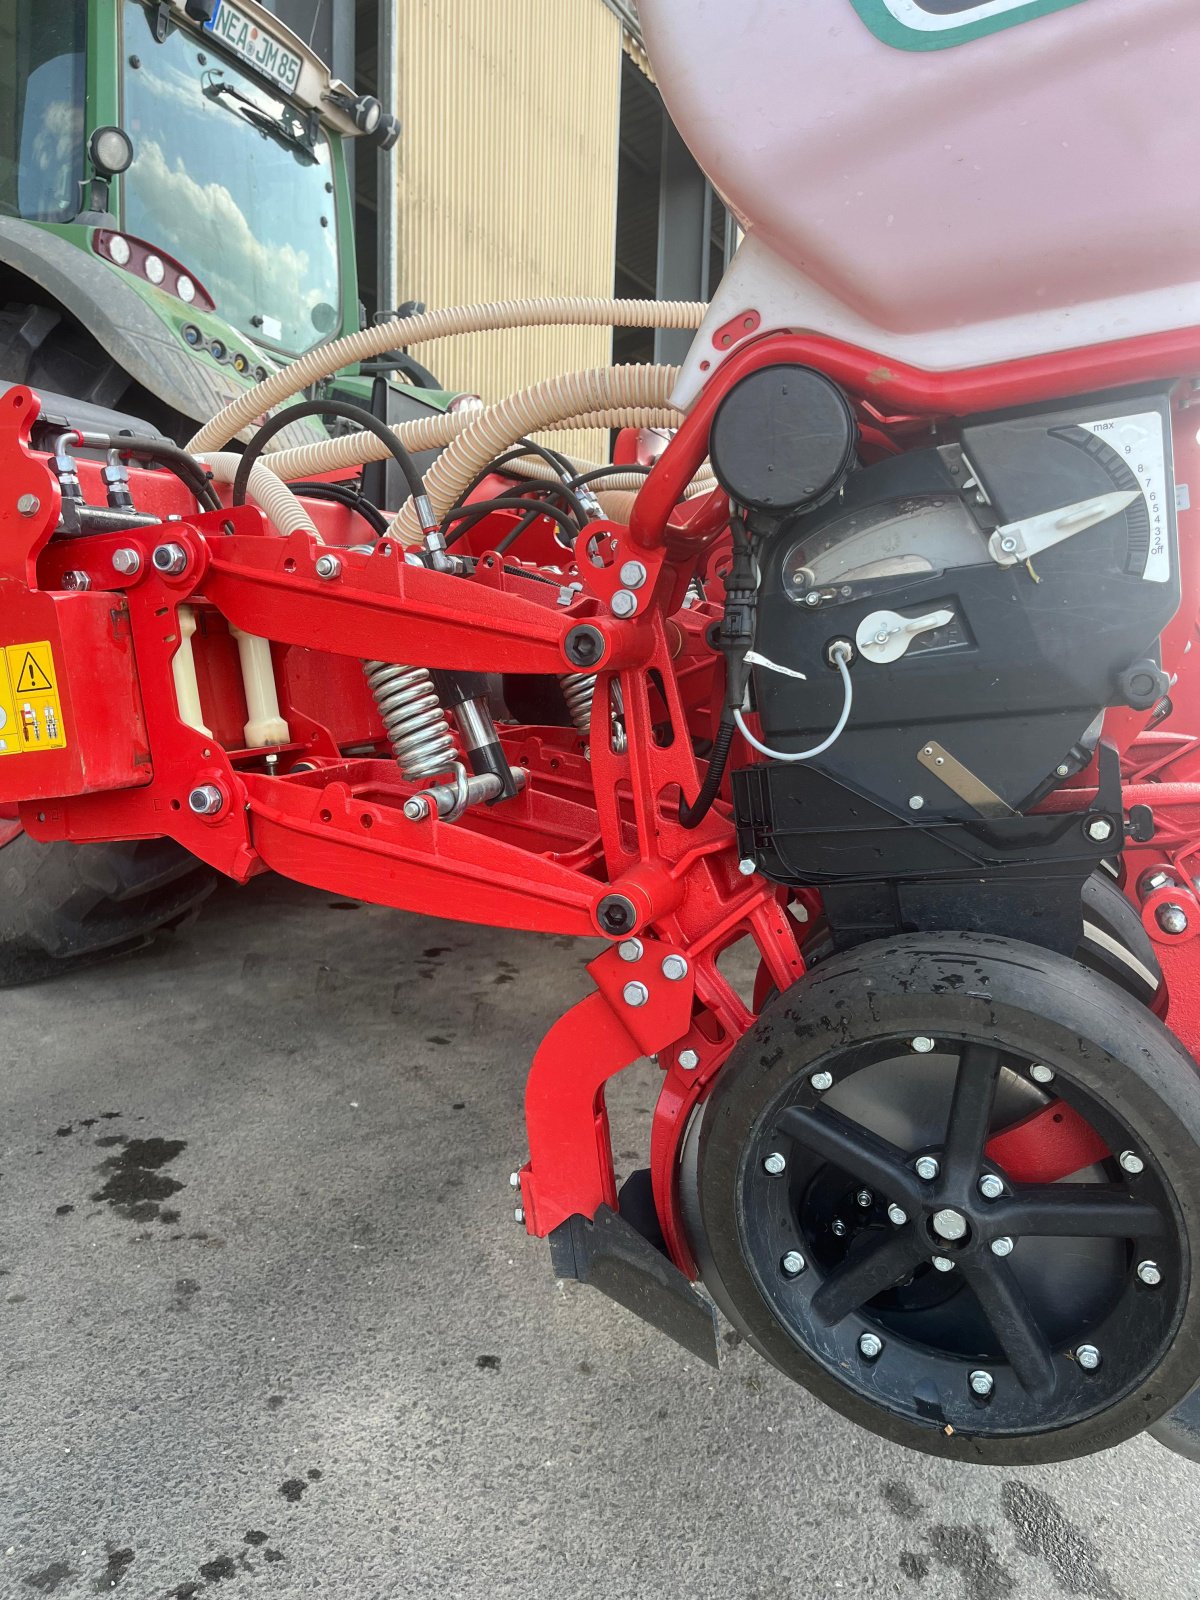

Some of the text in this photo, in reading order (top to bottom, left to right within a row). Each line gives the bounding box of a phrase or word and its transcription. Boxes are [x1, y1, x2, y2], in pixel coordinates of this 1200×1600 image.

[215, 5, 249, 51] NEA
[255, 37, 279, 72] JM
[277, 53, 298, 85] 85
[1093, 421, 1115, 432] max
[1124, 445, 1132, 455] 9
[1137, 464, 1144, 473] 8
[1145, 478, 1152, 488] 7
[1149, 491, 1157, 501] 6
[1152, 503, 1159, 513] 5
[1154, 515, 1161, 525] 4
[1154, 527, 1161, 536] 3
[1154, 537, 1161, 546] 2
[1150, 545, 1164, 555] off
